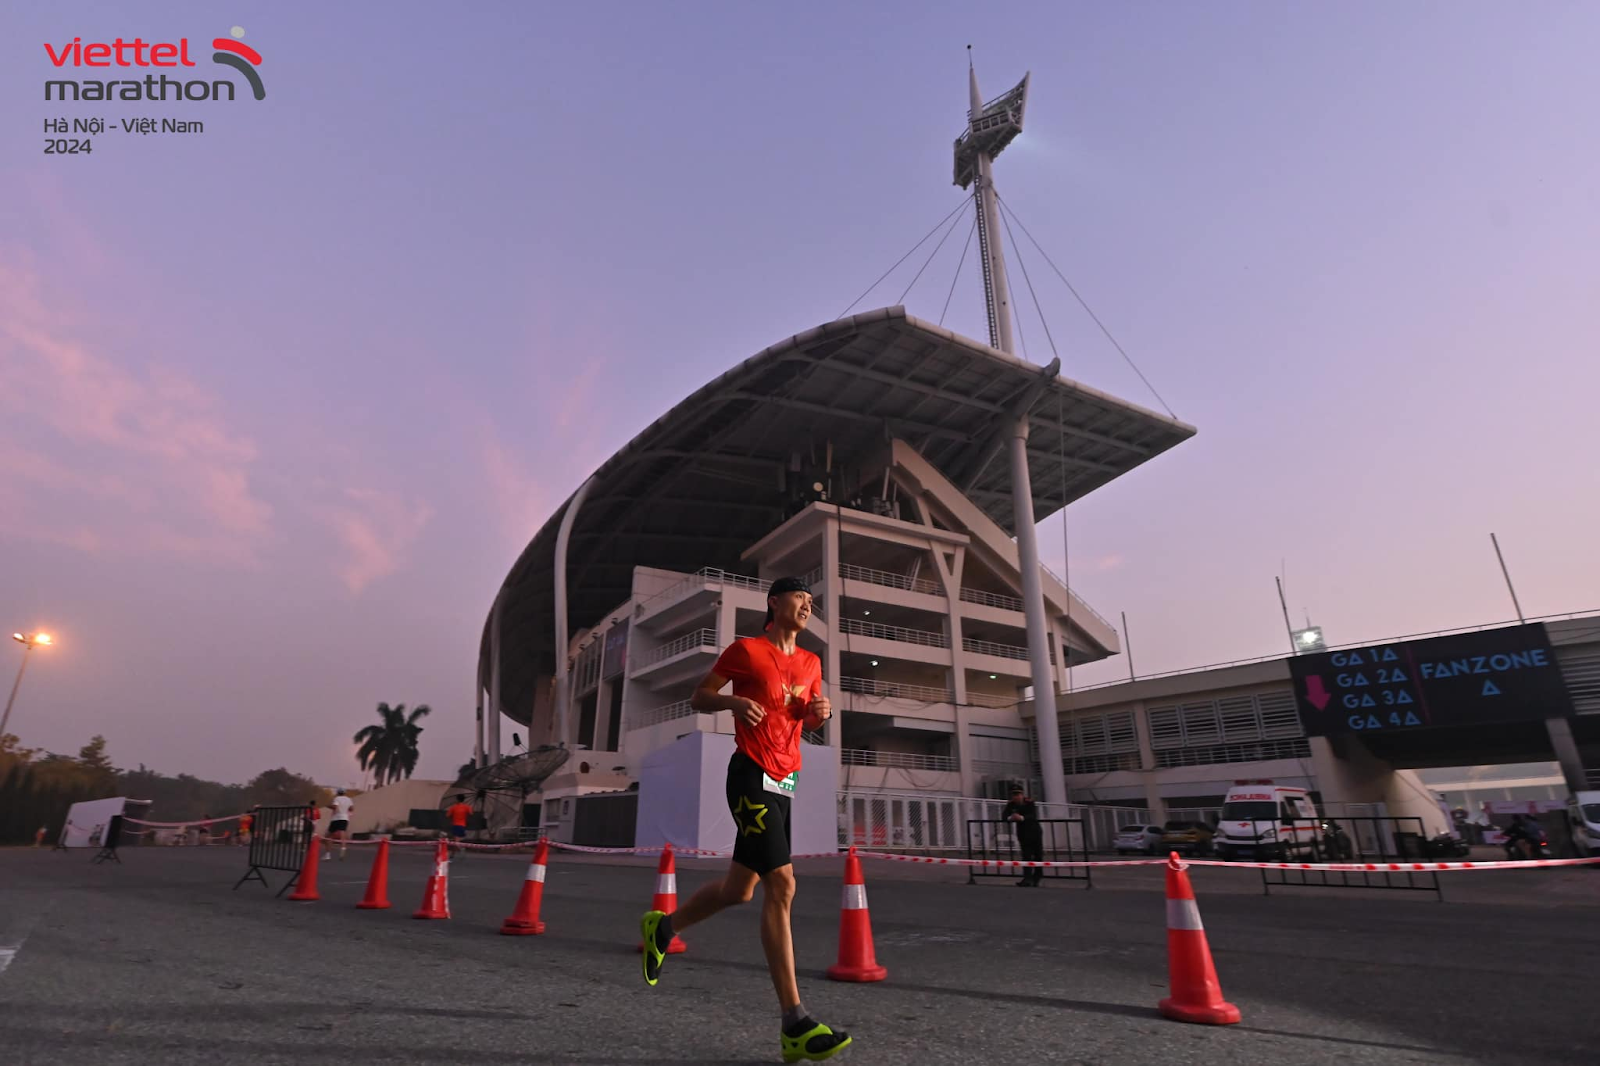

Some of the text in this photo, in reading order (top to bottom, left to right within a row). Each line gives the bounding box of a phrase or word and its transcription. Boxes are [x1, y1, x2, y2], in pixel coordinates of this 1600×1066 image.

[1331, 652, 1364, 667] GA
[1420, 648, 1549, 679] FANZONE
[1336, 667, 1409, 687] GA 2A
[1343, 688, 1414, 709] GA 3A
[1348, 710, 1422, 730] GA 4A
